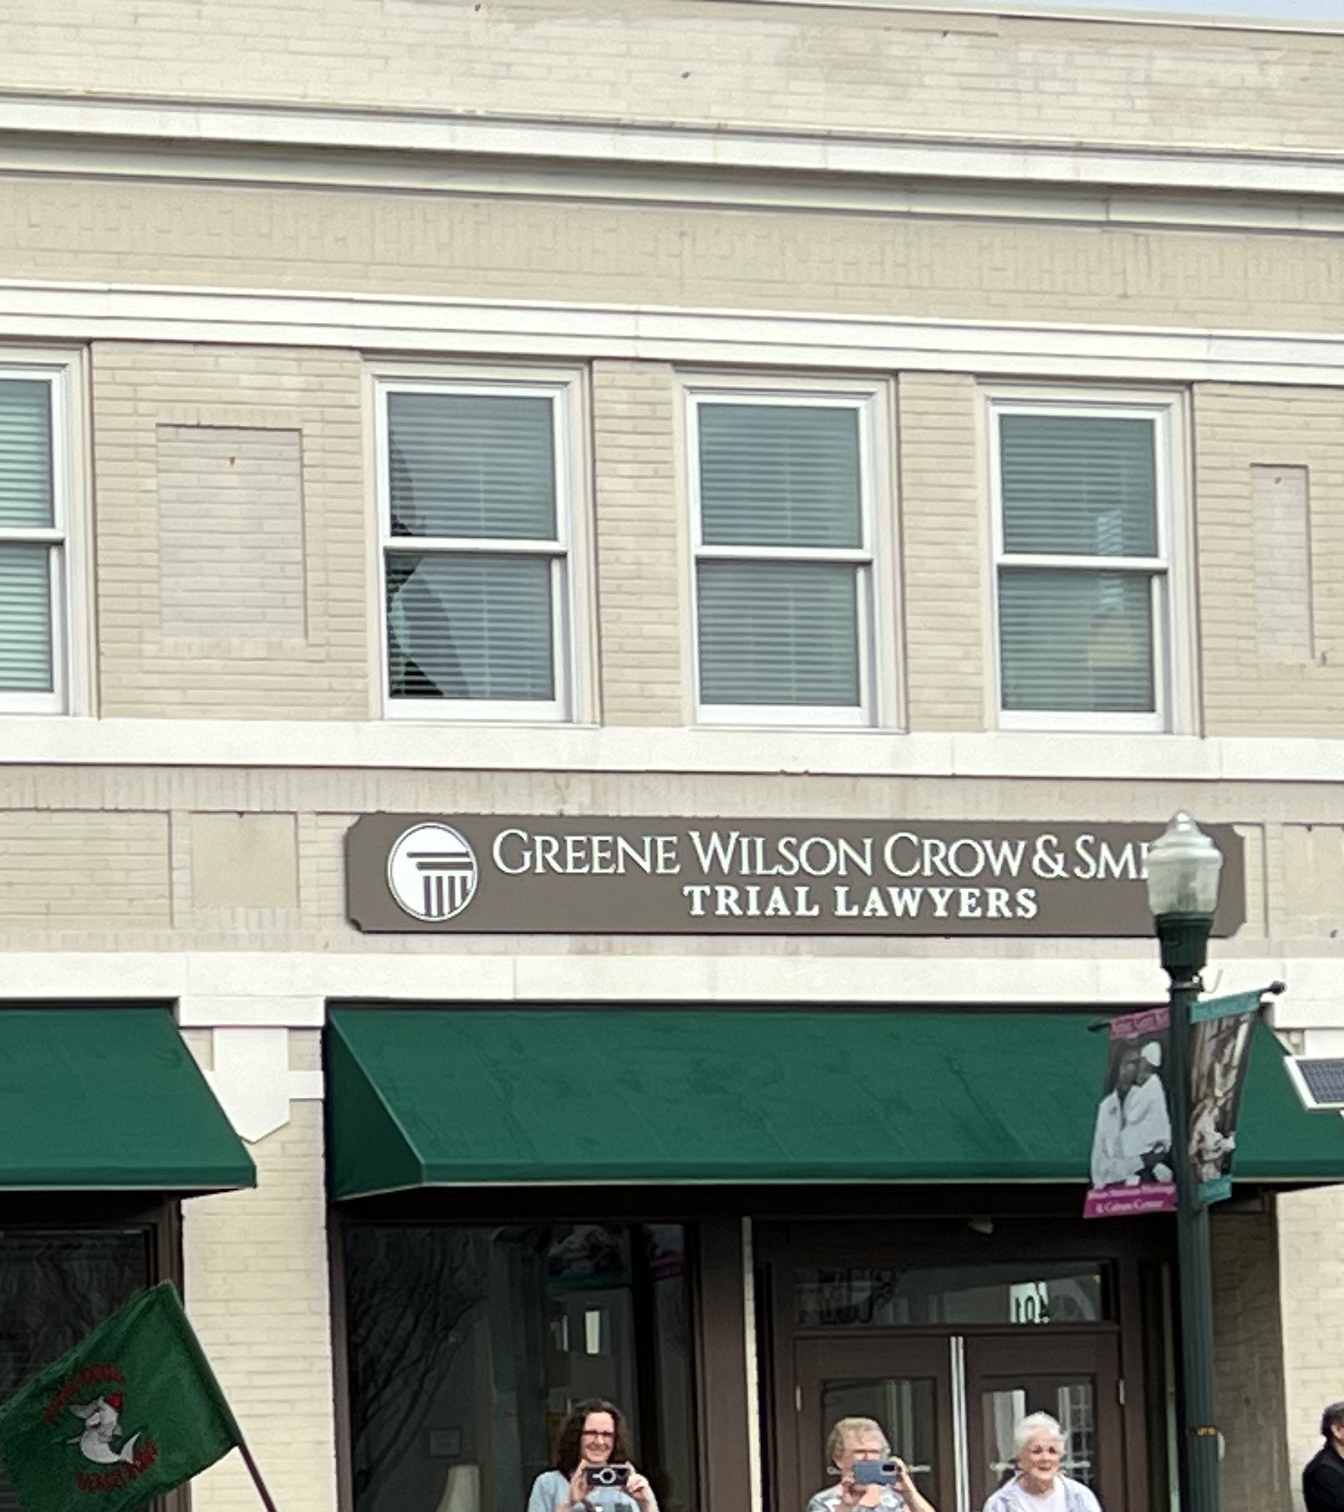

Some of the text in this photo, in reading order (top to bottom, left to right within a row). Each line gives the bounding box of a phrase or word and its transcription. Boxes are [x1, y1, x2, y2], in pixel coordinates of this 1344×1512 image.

[492, 829, 681, 876] GREENE
[688, 831, 873, 878] WILSON
[880, 834, 1033, 879] CROW
[683, 885, 1039, 920] TRIAL LAWYERS
